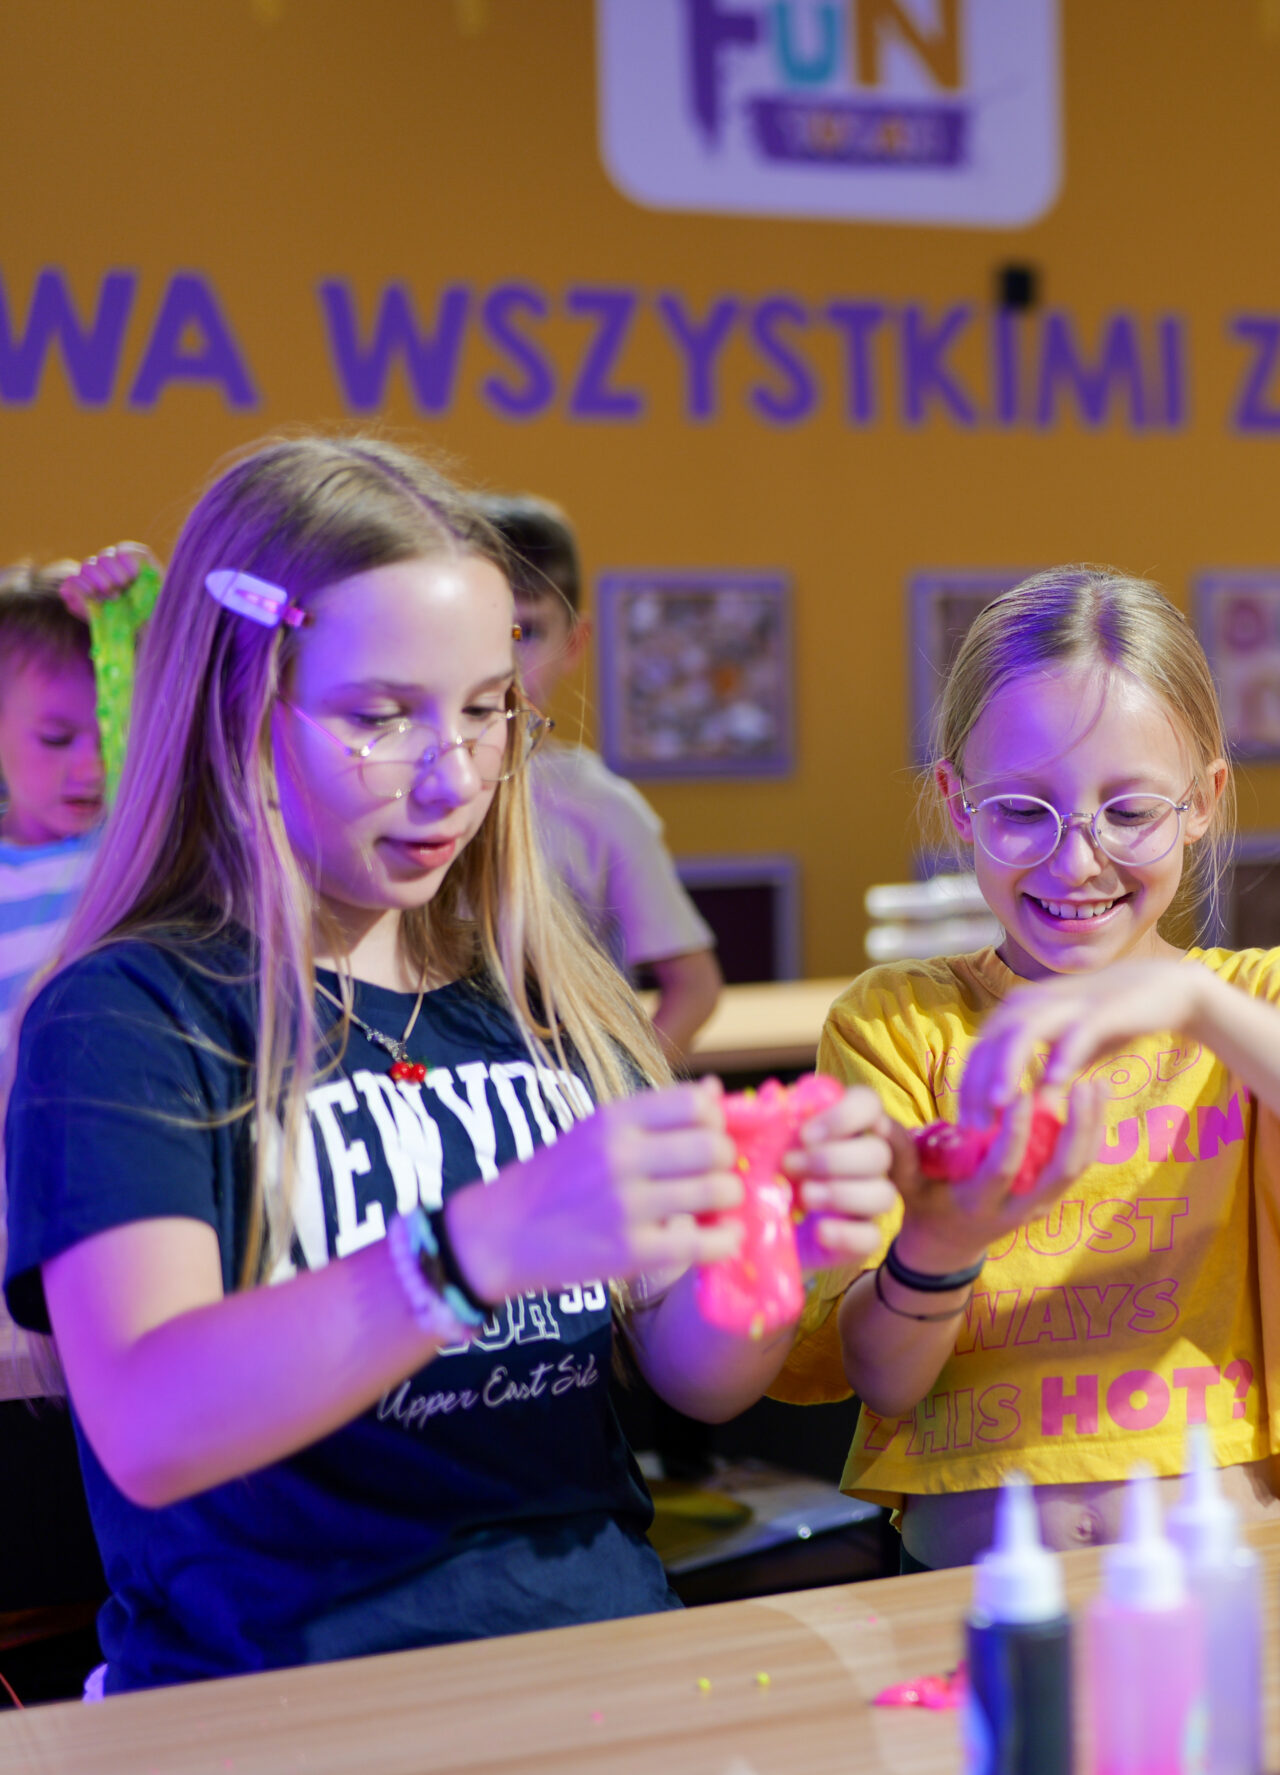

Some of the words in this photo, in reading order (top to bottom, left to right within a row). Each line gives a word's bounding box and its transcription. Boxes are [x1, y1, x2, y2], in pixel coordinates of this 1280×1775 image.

[684, 0, 964, 154] FUN
[1097, 1086, 1250, 1165] URN
[1040, 1358, 1254, 1437] HOT?
